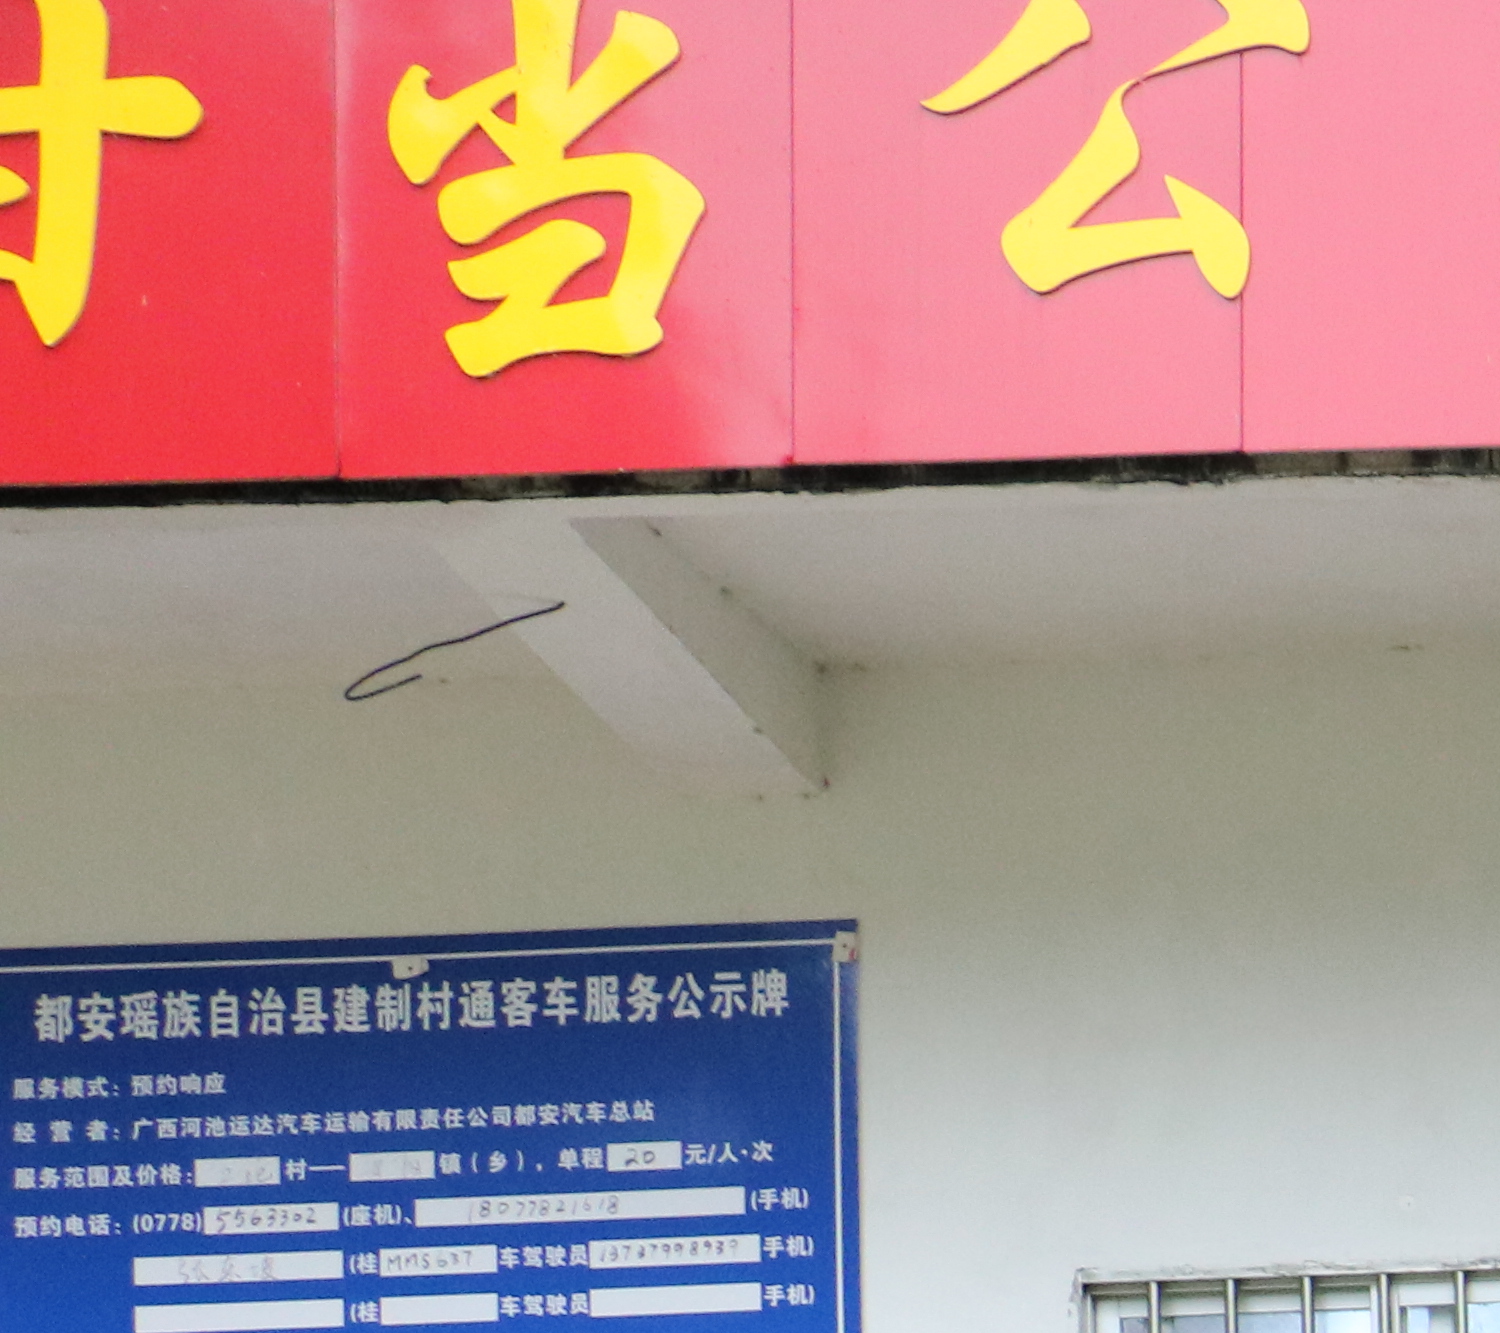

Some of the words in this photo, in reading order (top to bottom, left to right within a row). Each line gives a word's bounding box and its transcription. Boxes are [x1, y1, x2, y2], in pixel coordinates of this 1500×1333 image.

[33, 970, 789, 1044] 都安瑶族自治县建制村通客车服务公示牌
